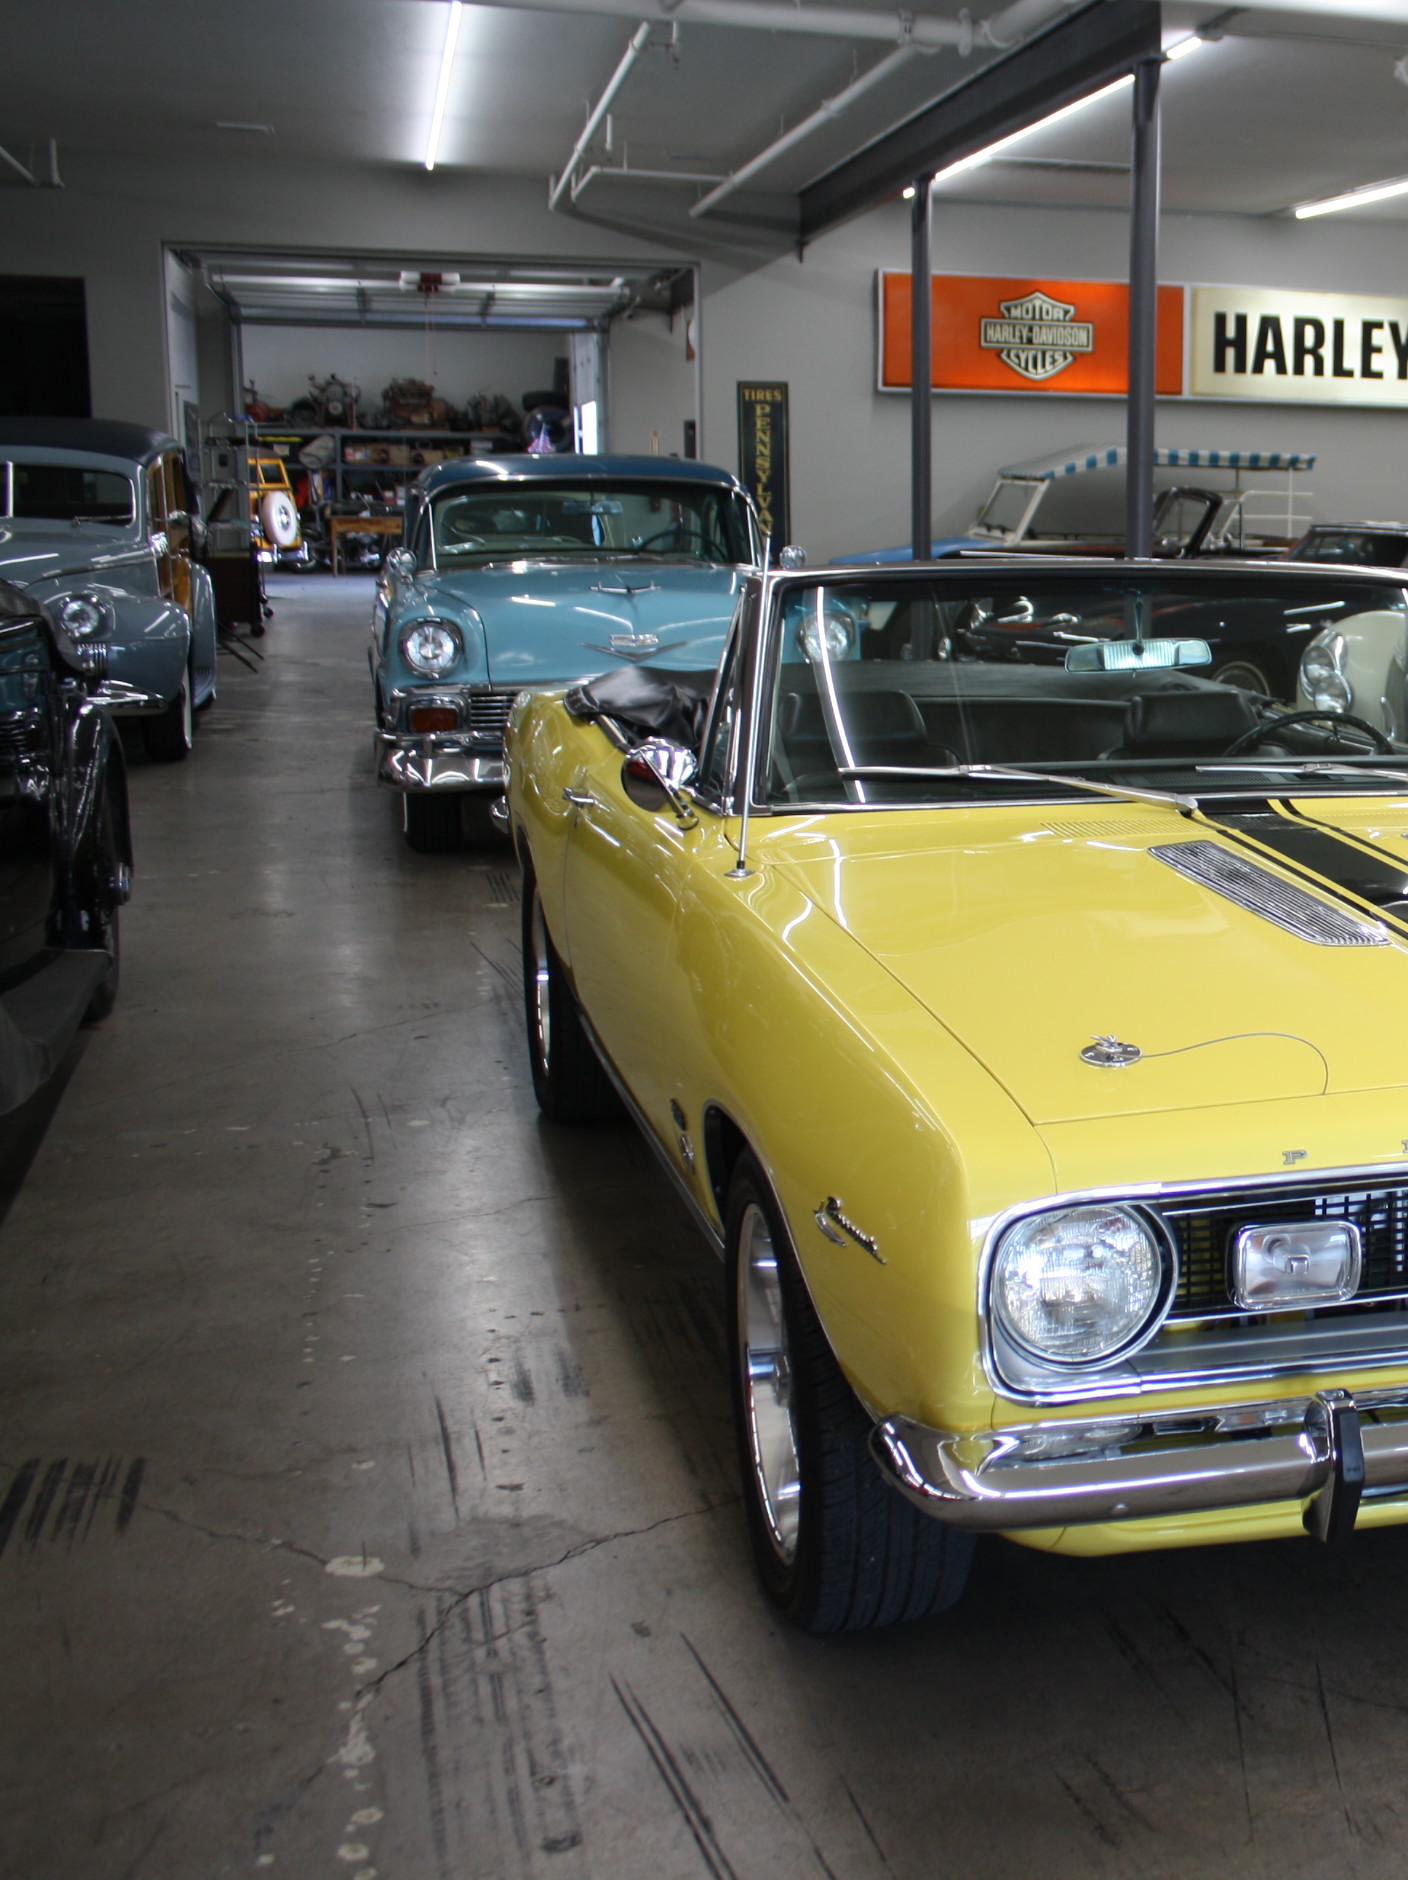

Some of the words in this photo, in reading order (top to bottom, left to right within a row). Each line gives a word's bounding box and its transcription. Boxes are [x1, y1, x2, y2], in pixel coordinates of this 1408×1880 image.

[1010, 300, 1065, 321] MOTOR
[986, 323, 1089, 346] HARLEY-DAVIDSON
[1009, 350, 1064, 374] CYCLES
[743, 388, 782, 402] TIRES
